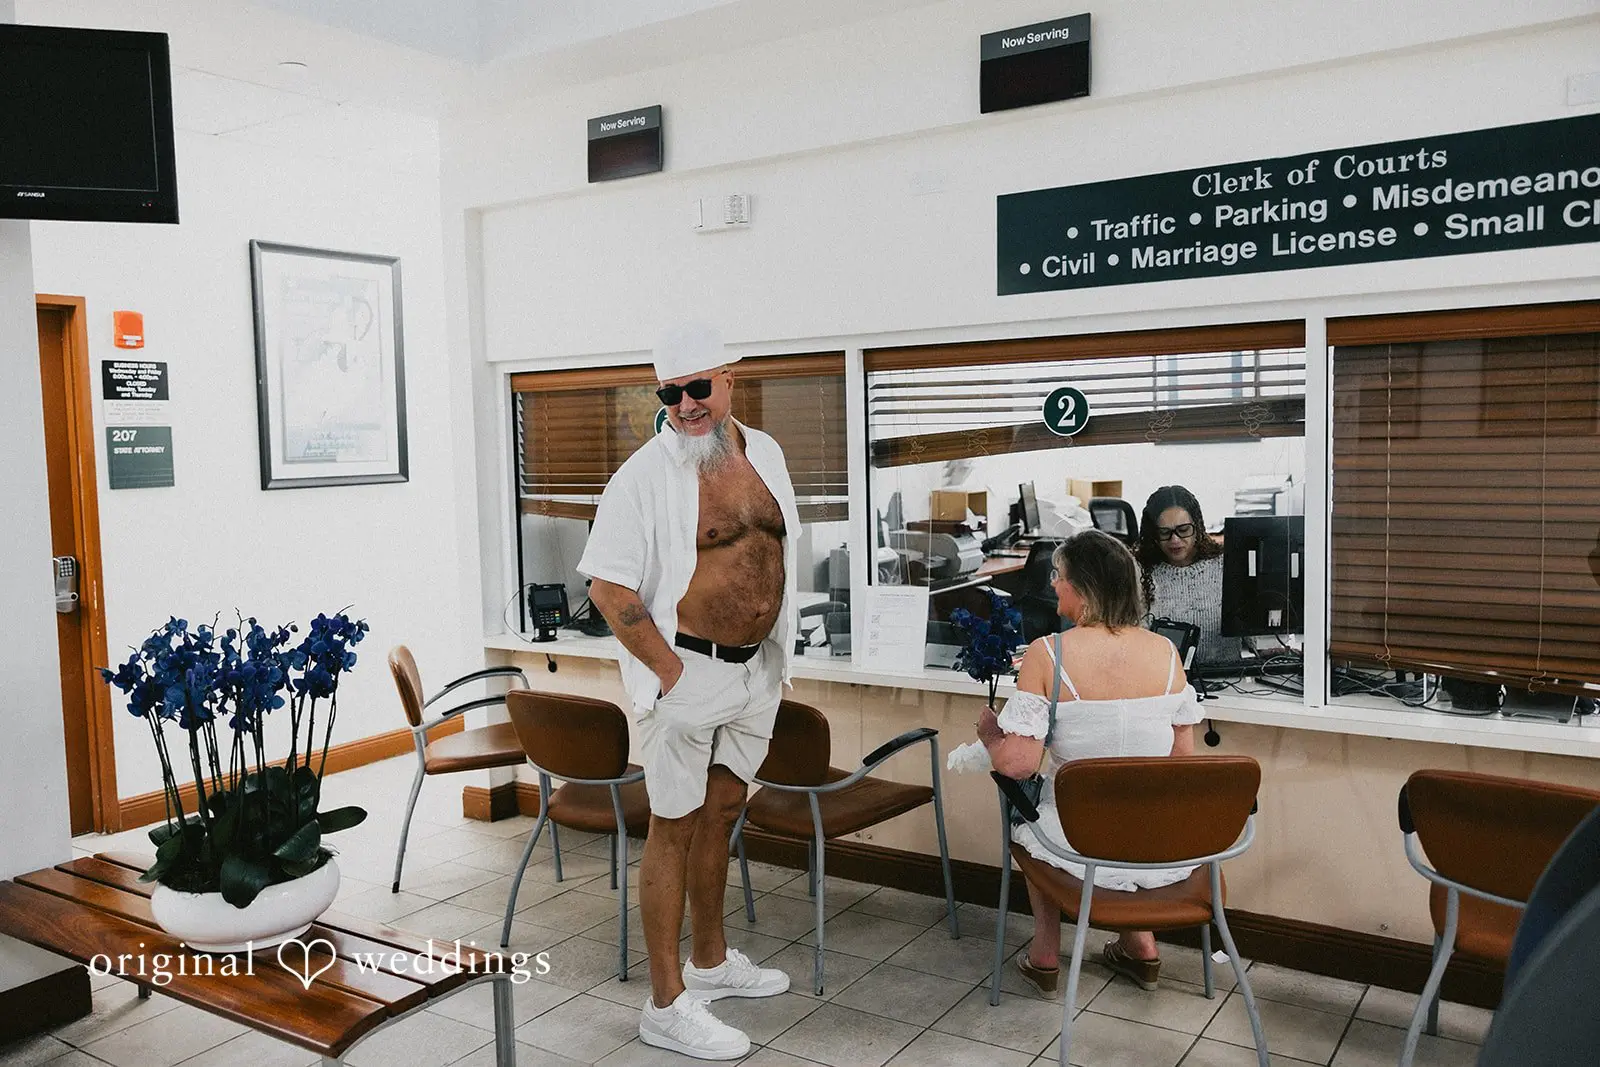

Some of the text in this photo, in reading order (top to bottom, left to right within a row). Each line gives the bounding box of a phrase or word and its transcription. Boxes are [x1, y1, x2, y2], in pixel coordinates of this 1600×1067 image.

[1001, 27, 1069, 49] Now Serving
[600, 116, 646, 132] Now Serving
[1192, 147, 1448, 197] Clerk of Courts
[1090, 166, 1600, 241] Traffic Parking Misdemeano
[1042, 252, 1095, 278] Civil
[1131, 240, 1257, 269] Marriage
[1272, 226, 1397, 256] License
[1444, 205, 1545, 239] Small
[1057, 395, 1076, 427] 2
[112, 429, 137, 442] 207
[134, 446, 165, 454] ATTORNEY
